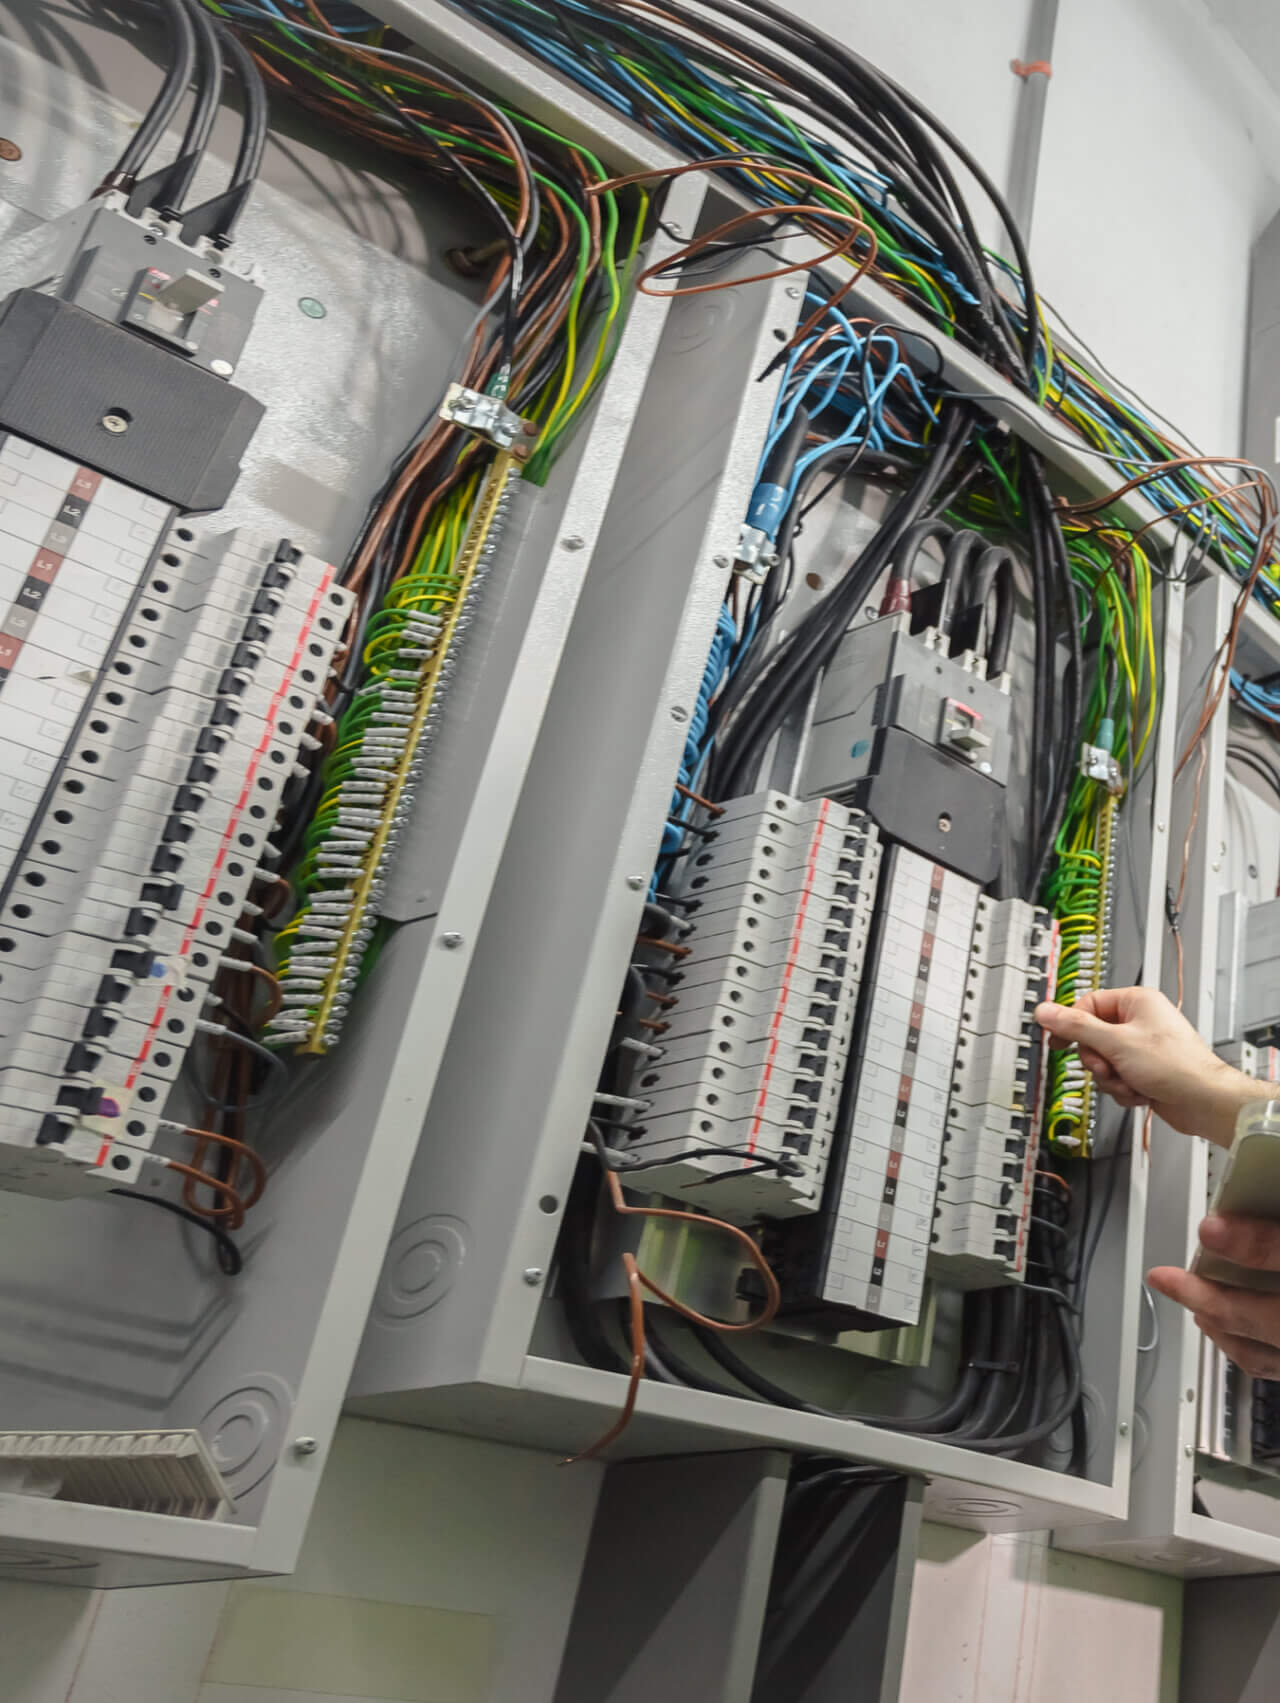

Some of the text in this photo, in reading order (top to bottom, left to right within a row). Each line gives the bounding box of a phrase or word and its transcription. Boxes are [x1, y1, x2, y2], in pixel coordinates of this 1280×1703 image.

[62, 504, 81, 517] L2
[35, 559, 53, 570] L1
[23, 587, 42, 599] L2
